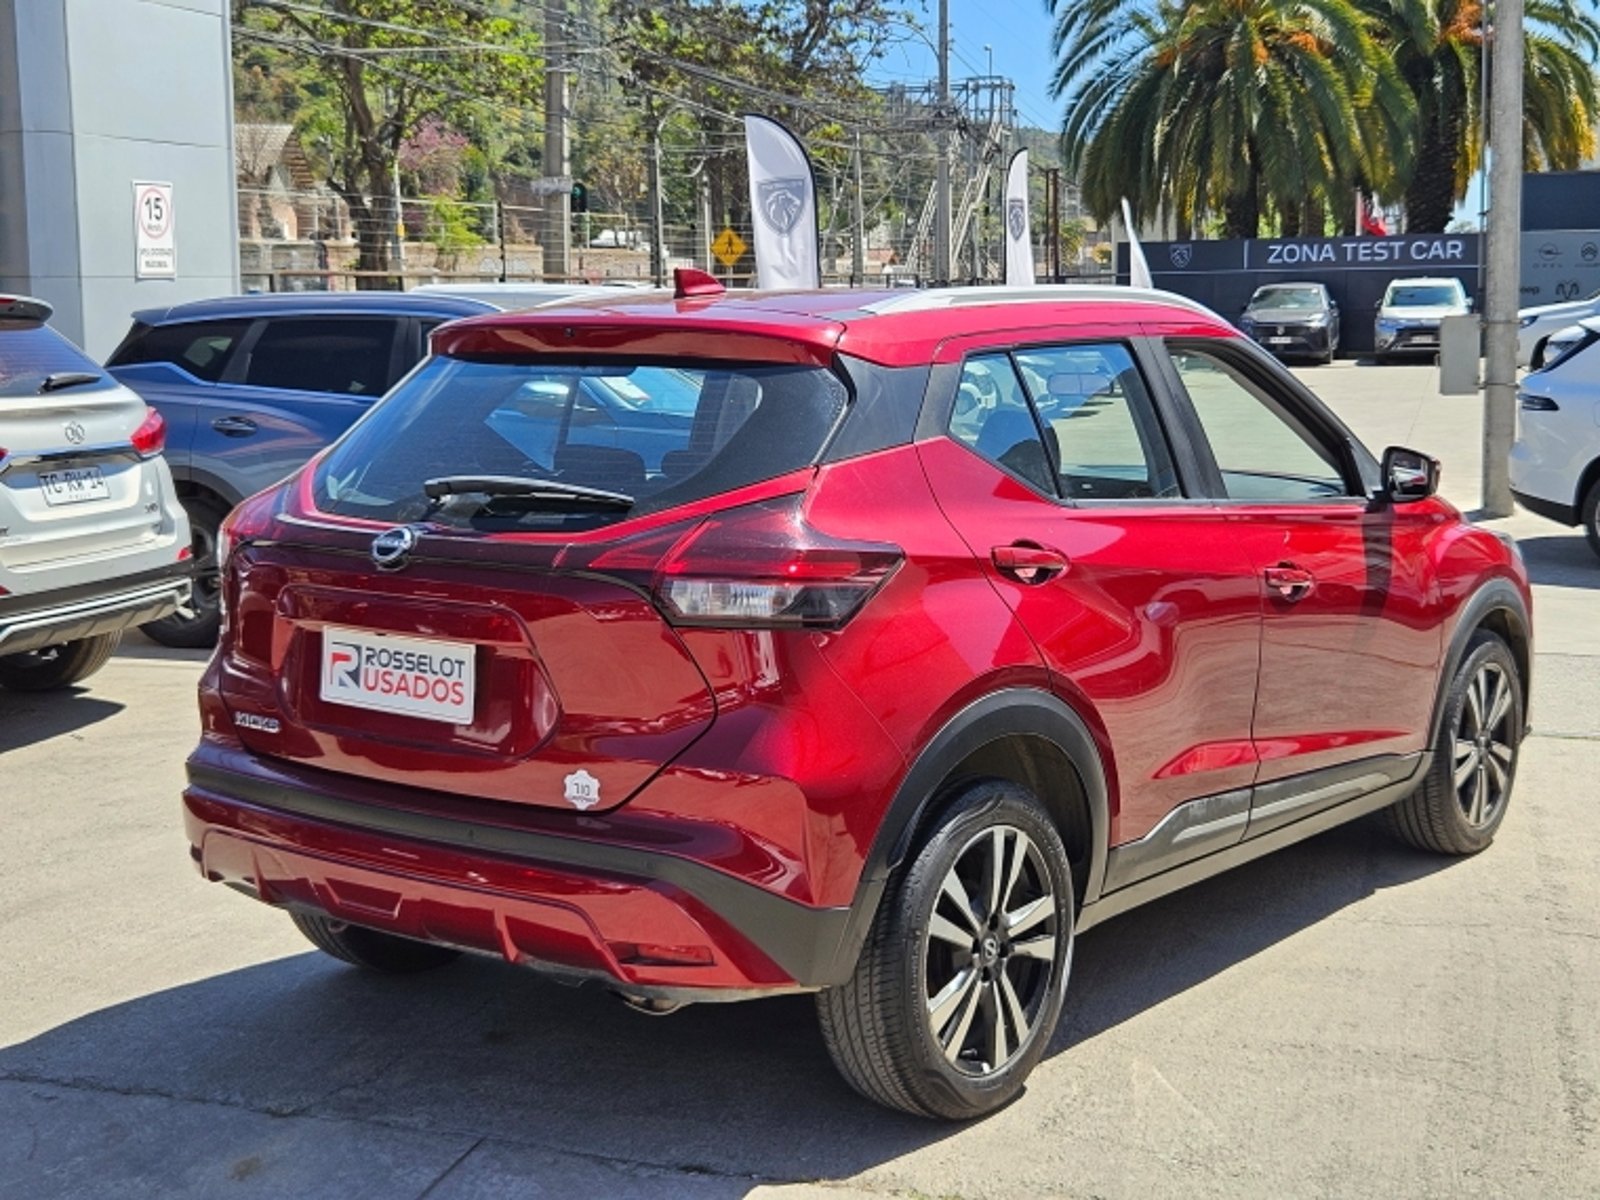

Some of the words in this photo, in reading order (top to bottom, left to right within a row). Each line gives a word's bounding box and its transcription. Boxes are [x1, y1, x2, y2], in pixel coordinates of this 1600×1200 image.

[145, 197, 163, 221] 15
[1267, 243, 1336, 264] ZONA
[1342, 241, 1405, 262] TEST
[1410, 239, 1464, 261] CAR
[365, 646, 466, 679] ROSSELOT
[363, 668, 465, 706] USADOS
